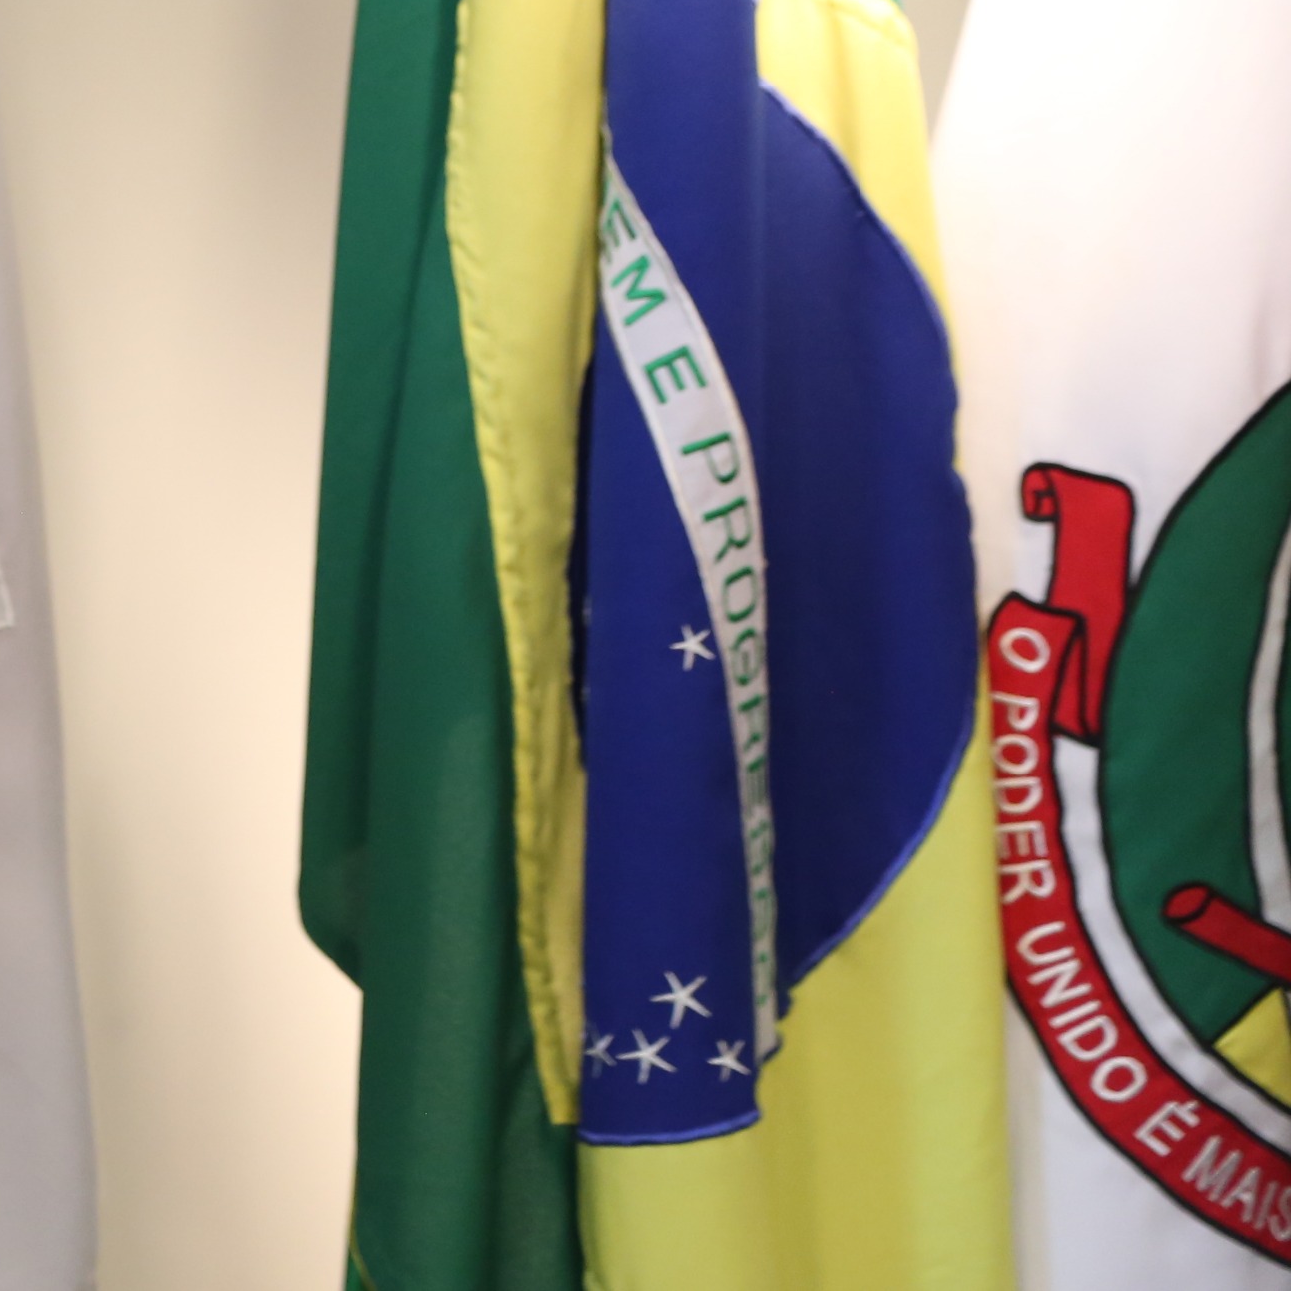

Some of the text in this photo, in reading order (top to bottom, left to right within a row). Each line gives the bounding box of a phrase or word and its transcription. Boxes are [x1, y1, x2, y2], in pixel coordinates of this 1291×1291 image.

[644, 345, 708, 404] E
[999, 627, 1050, 673] O
[992, 690, 1056, 904] PODER
[1016, 921, 1148, 1102] UNIDO
[1133, 1099, 1201, 1157] É
